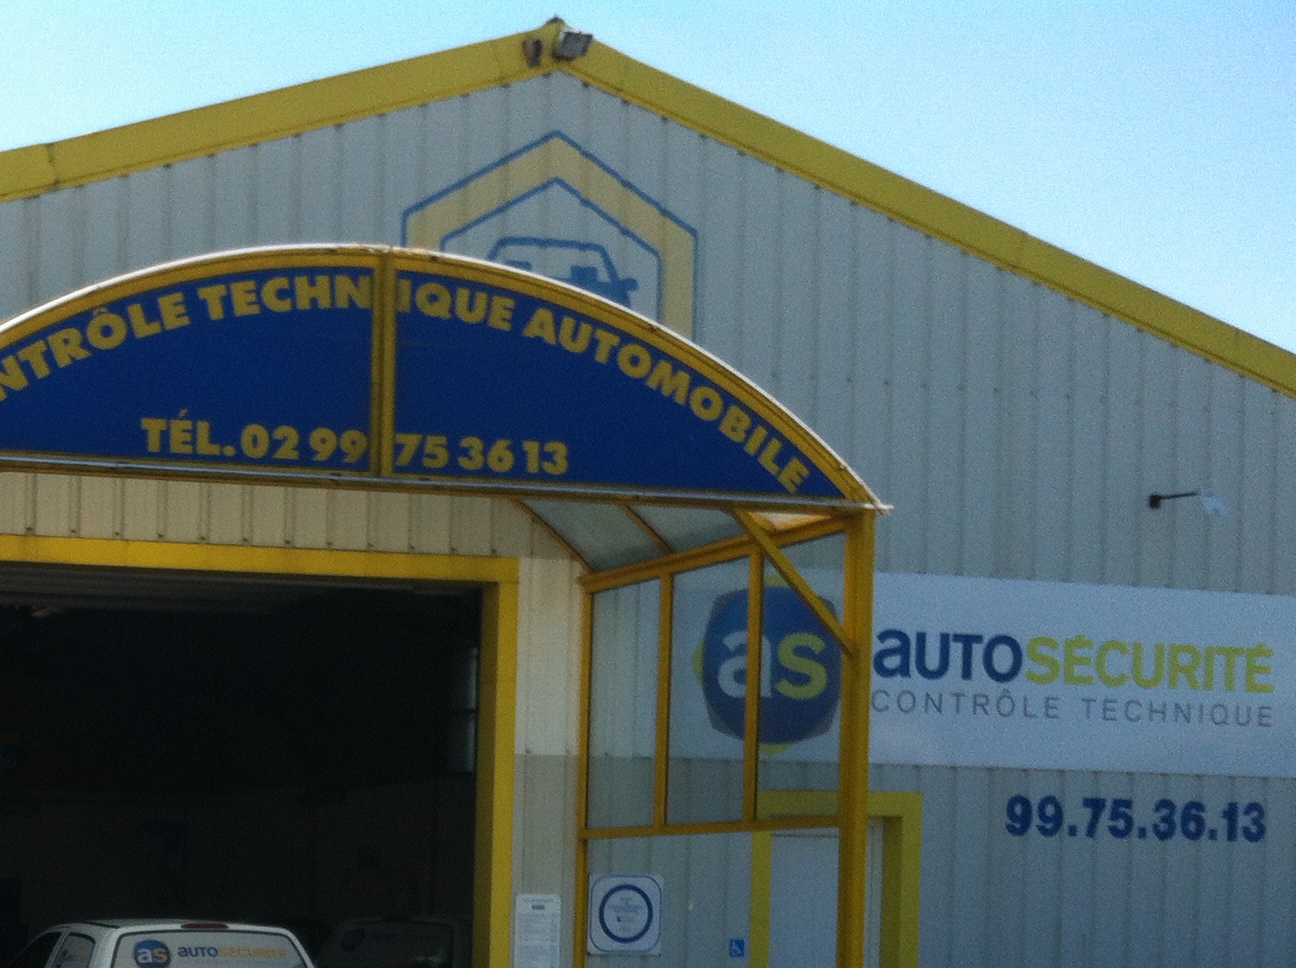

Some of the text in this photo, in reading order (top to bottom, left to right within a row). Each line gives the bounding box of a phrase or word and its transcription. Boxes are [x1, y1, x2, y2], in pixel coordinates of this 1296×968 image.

[198, 274, 514, 331] TECHNIQUE
[523, 307, 811, 493] AUTOMOBILE
[141, 408, 569, 476] TÉL. 02 99 75 36 13
[871, 687, 1273, 728] CONTRÔLE TECHNIQUE
[1005, 795, 1267, 843] 99.75.36.13
